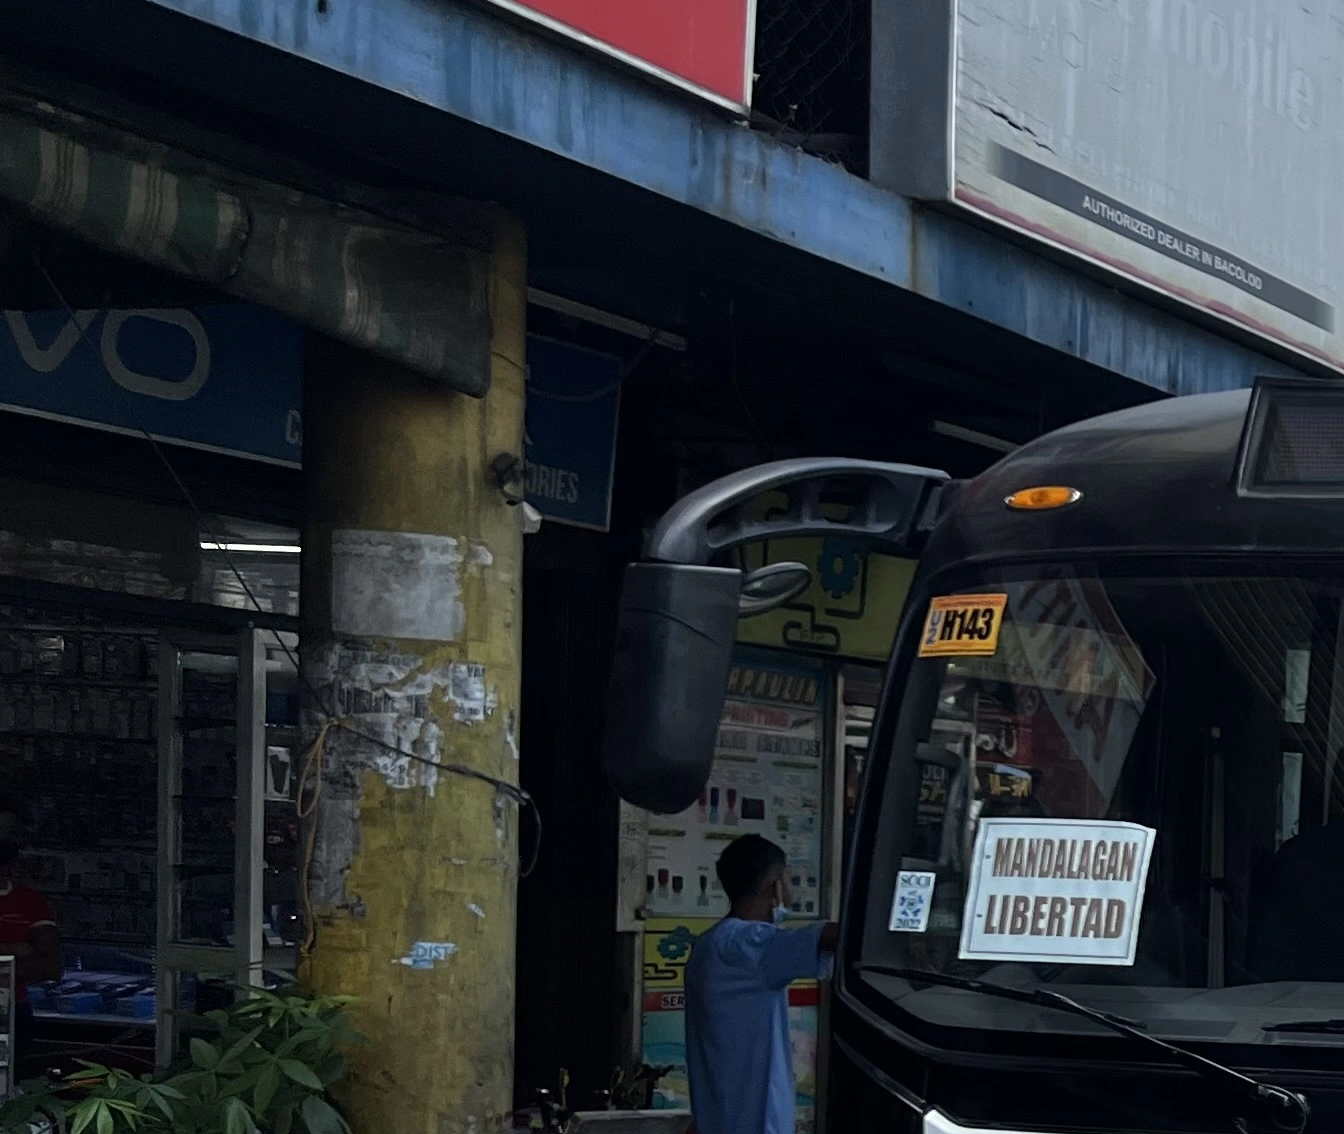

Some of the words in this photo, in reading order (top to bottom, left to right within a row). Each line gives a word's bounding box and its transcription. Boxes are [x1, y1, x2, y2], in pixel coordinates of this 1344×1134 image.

[1082, 195, 1155, 241] AUTHORIZED
[1157, 230, 1201, 262] DEALER
[1201, 253, 1213, 267] IN
[1214, 255, 1263, 290] BACOLOD
[939, 607, 994, 641] H143
[992, 837, 1139, 884] MANDALAGAN
[982, 893, 1127, 940] LIBERTAD
